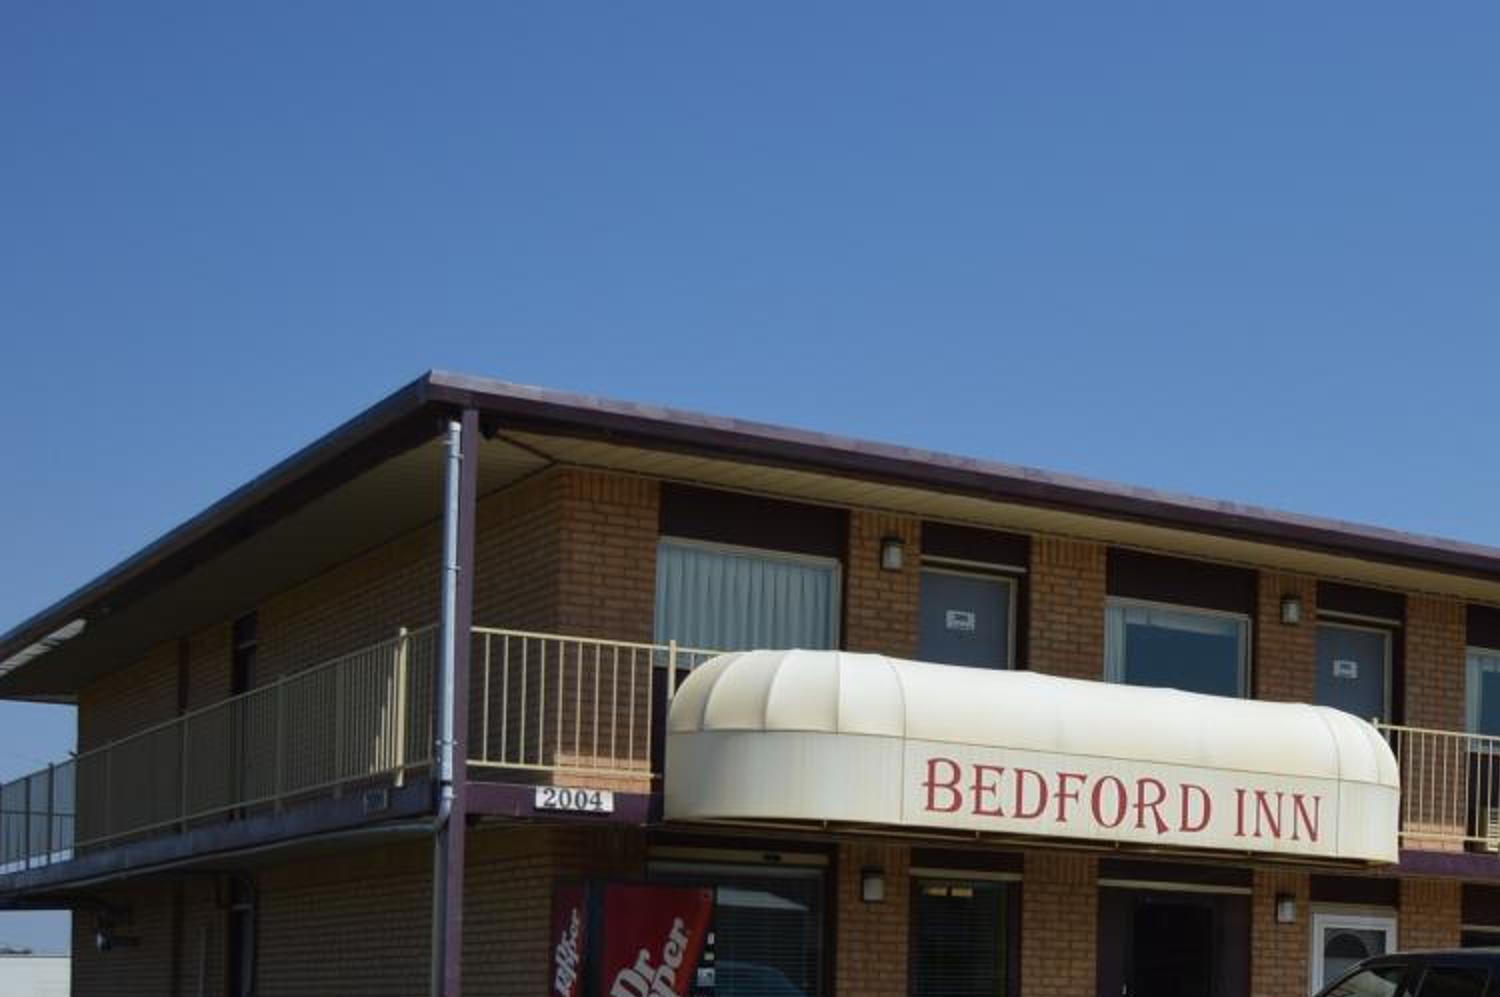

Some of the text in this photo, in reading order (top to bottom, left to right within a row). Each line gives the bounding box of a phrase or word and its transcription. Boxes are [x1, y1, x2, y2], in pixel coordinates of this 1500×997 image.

[543, 787, 604, 811] 2004
[922, 757, 1321, 842] BEDFORD INN
